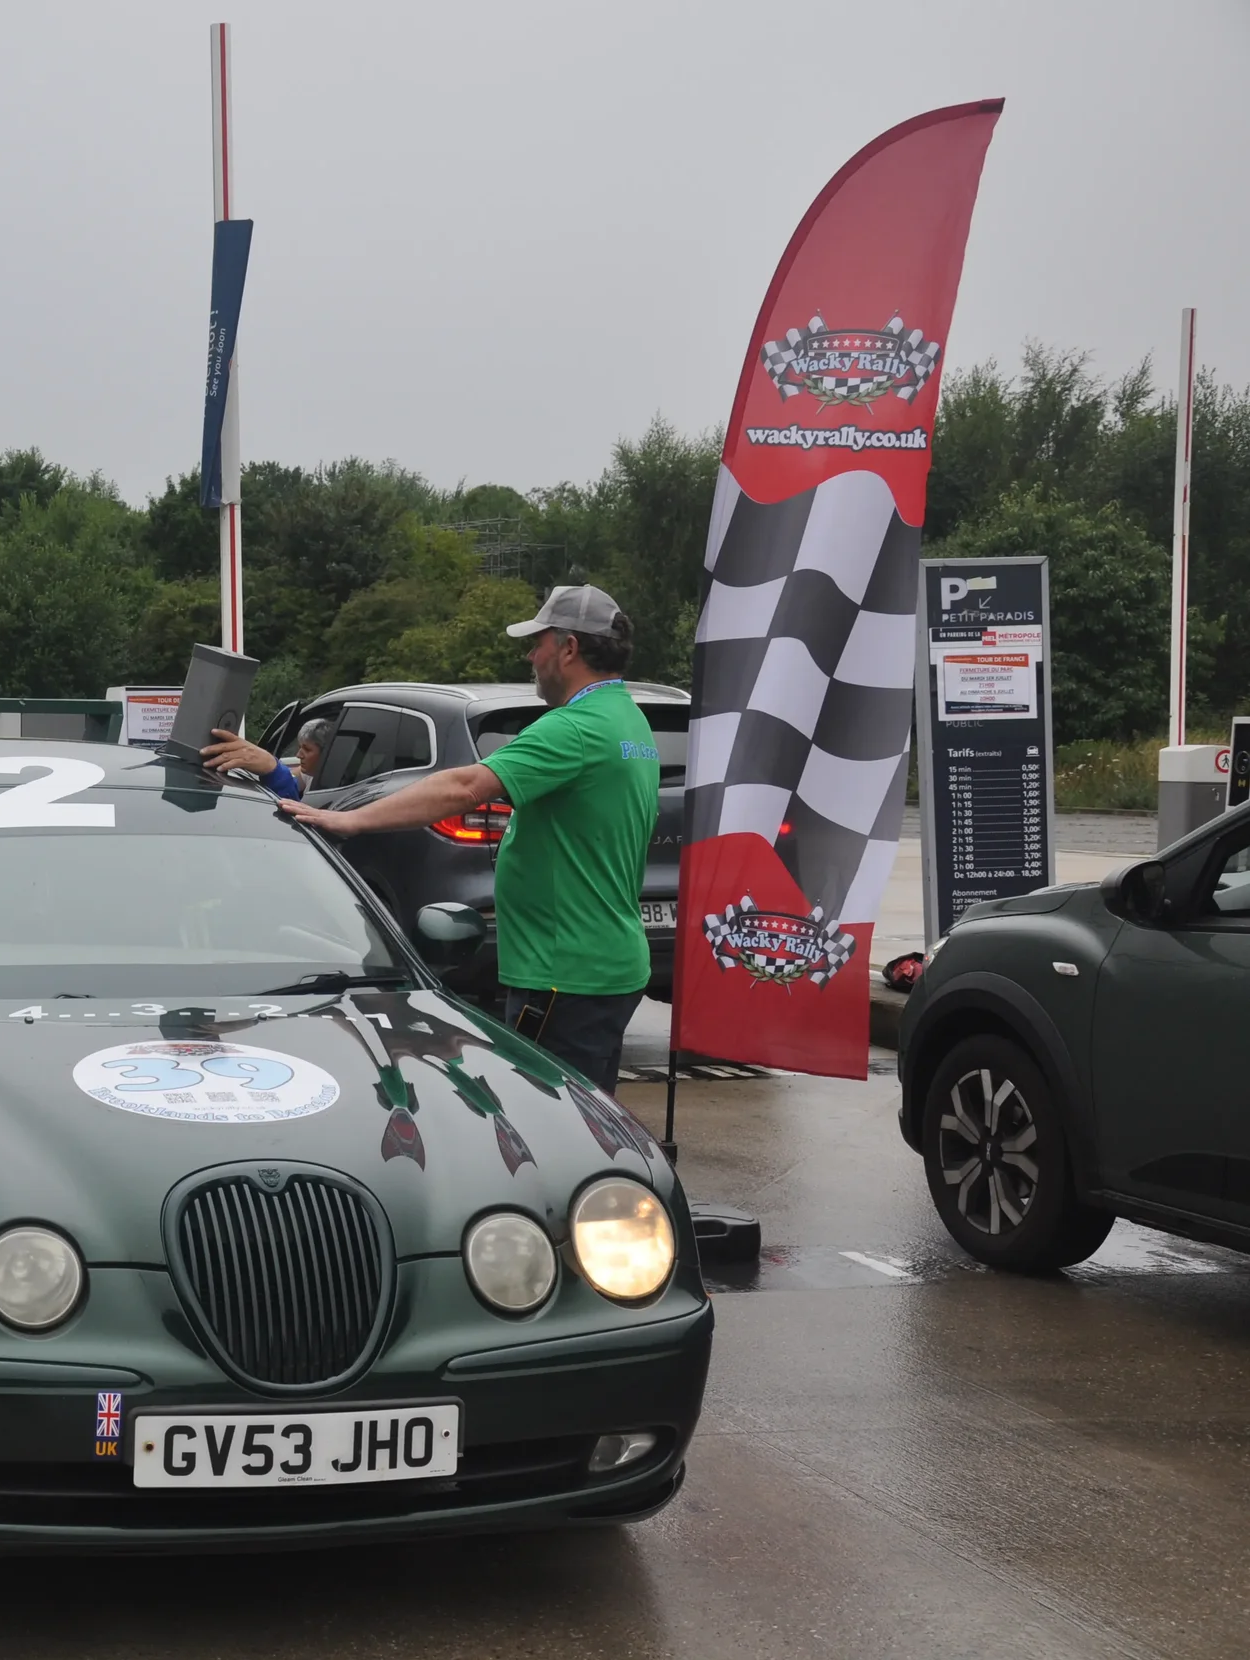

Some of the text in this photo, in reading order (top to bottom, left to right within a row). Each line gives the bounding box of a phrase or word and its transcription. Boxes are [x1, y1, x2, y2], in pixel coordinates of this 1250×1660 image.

[210, 328, 226, 397] See you soon
[791, 352, 910, 378] Wacky Rally
[747, 425, 927, 450] wackyrally.co.uk
[942, 611, 1034, 622] PETIT PARADIS
[946, 720, 984, 728] PUBLIC
[620, 741, 638, 759] Pit
[947, 748, 975, 758] Tarifs
[726, 930, 824, 963] Wacky Rally
[8, 1006, 49, 1018] 4
[131, 1003, 167, 1016] 3
[248, 1004, 287, 1016] 2
[364, 1012, 393, 1029] 1
[101, 1056, 295, 1092] 39
[88, 1087, 229, 1121] Brooklands
[235, 1112, 265, 1121] to
[95, 1442, 117, 1456] UK
[163, 1417, 435, 1476] GV53 JHO
